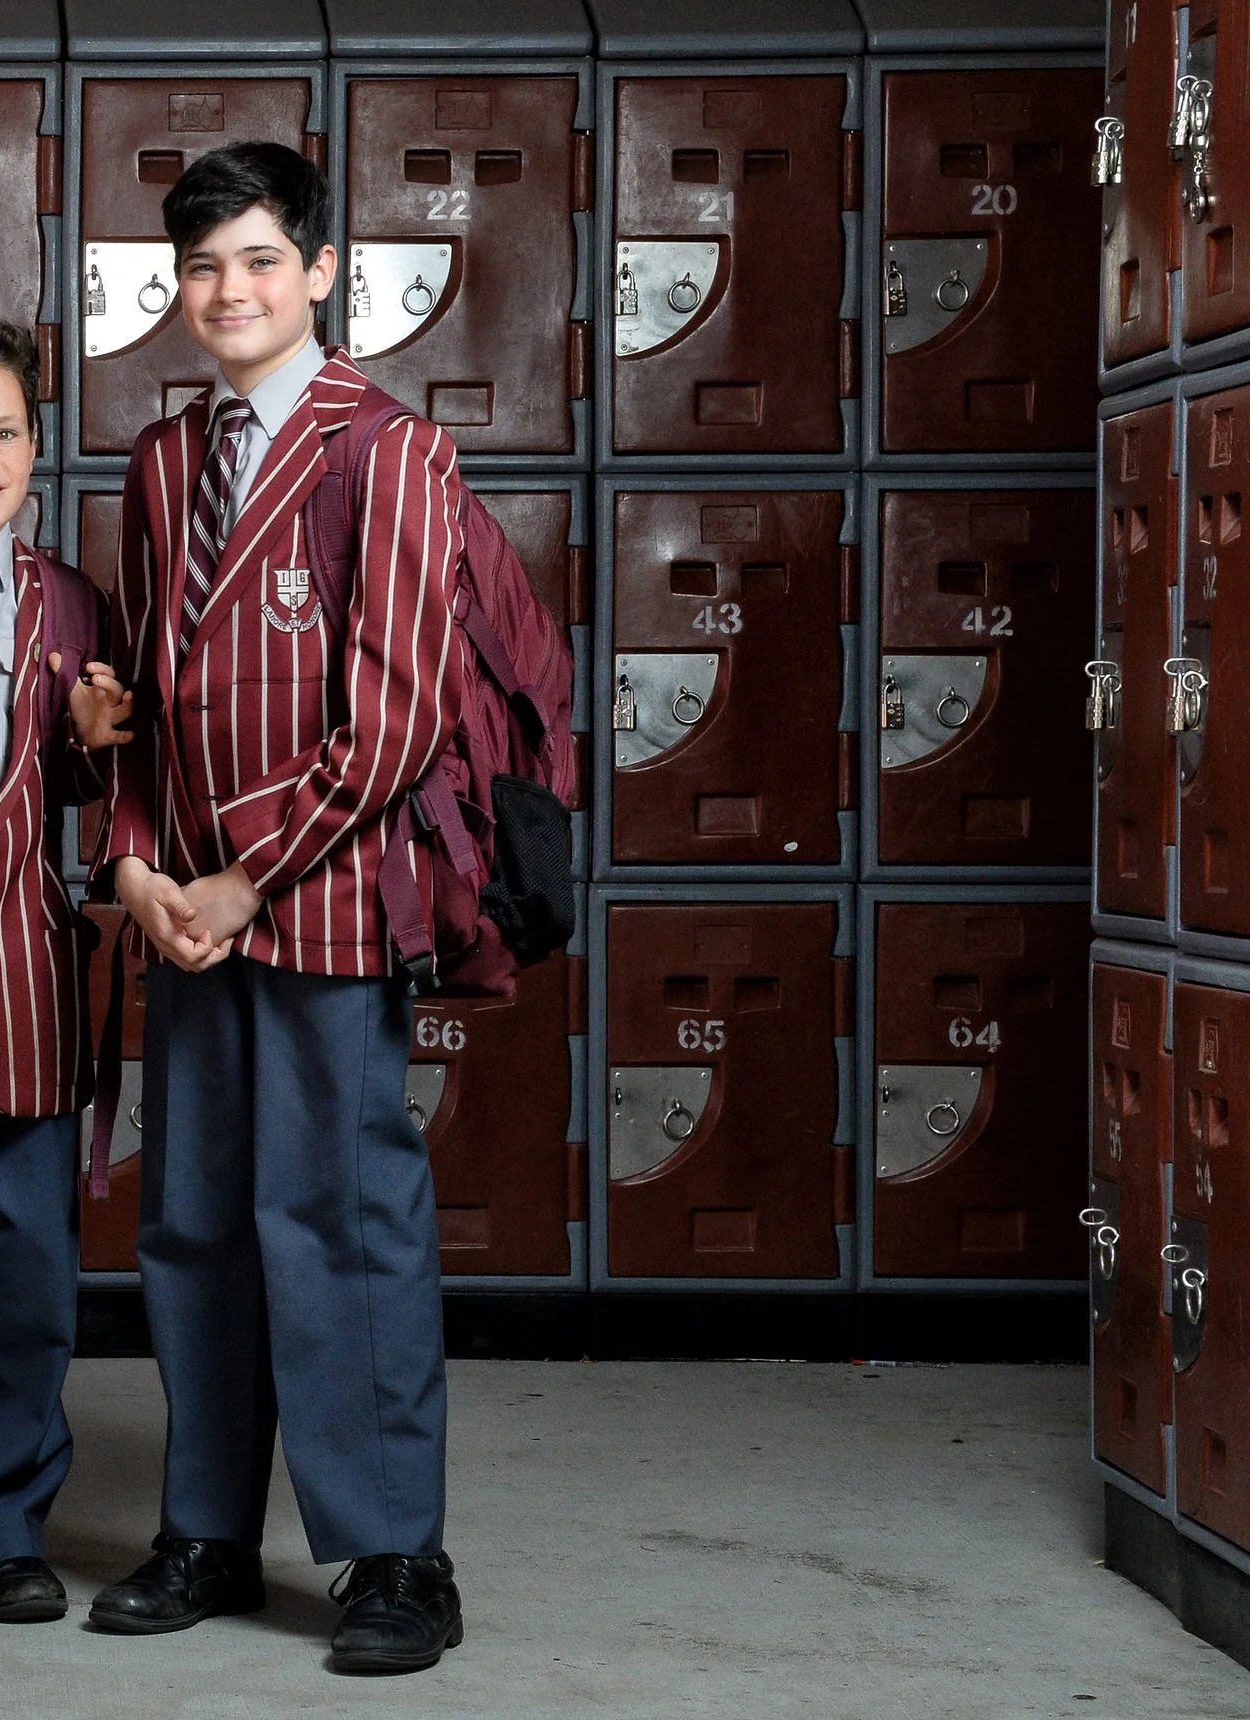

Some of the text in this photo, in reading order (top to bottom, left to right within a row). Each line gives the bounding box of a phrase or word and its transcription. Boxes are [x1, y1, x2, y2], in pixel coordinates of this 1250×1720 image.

[427, 189, 472, 220] 22
[698, 191, 734, 222] 21
[971, 184, 1018, 216] 20
[1203, 555, 1218, 600] 32
[691, 603, 743, 636] 43
[961, 605, 1014, 637] 42
[415, 1016, 467, 1051] 66
[676, 1018, 726, 1053] 65
[948, 1016, 1003, 1054] 64
